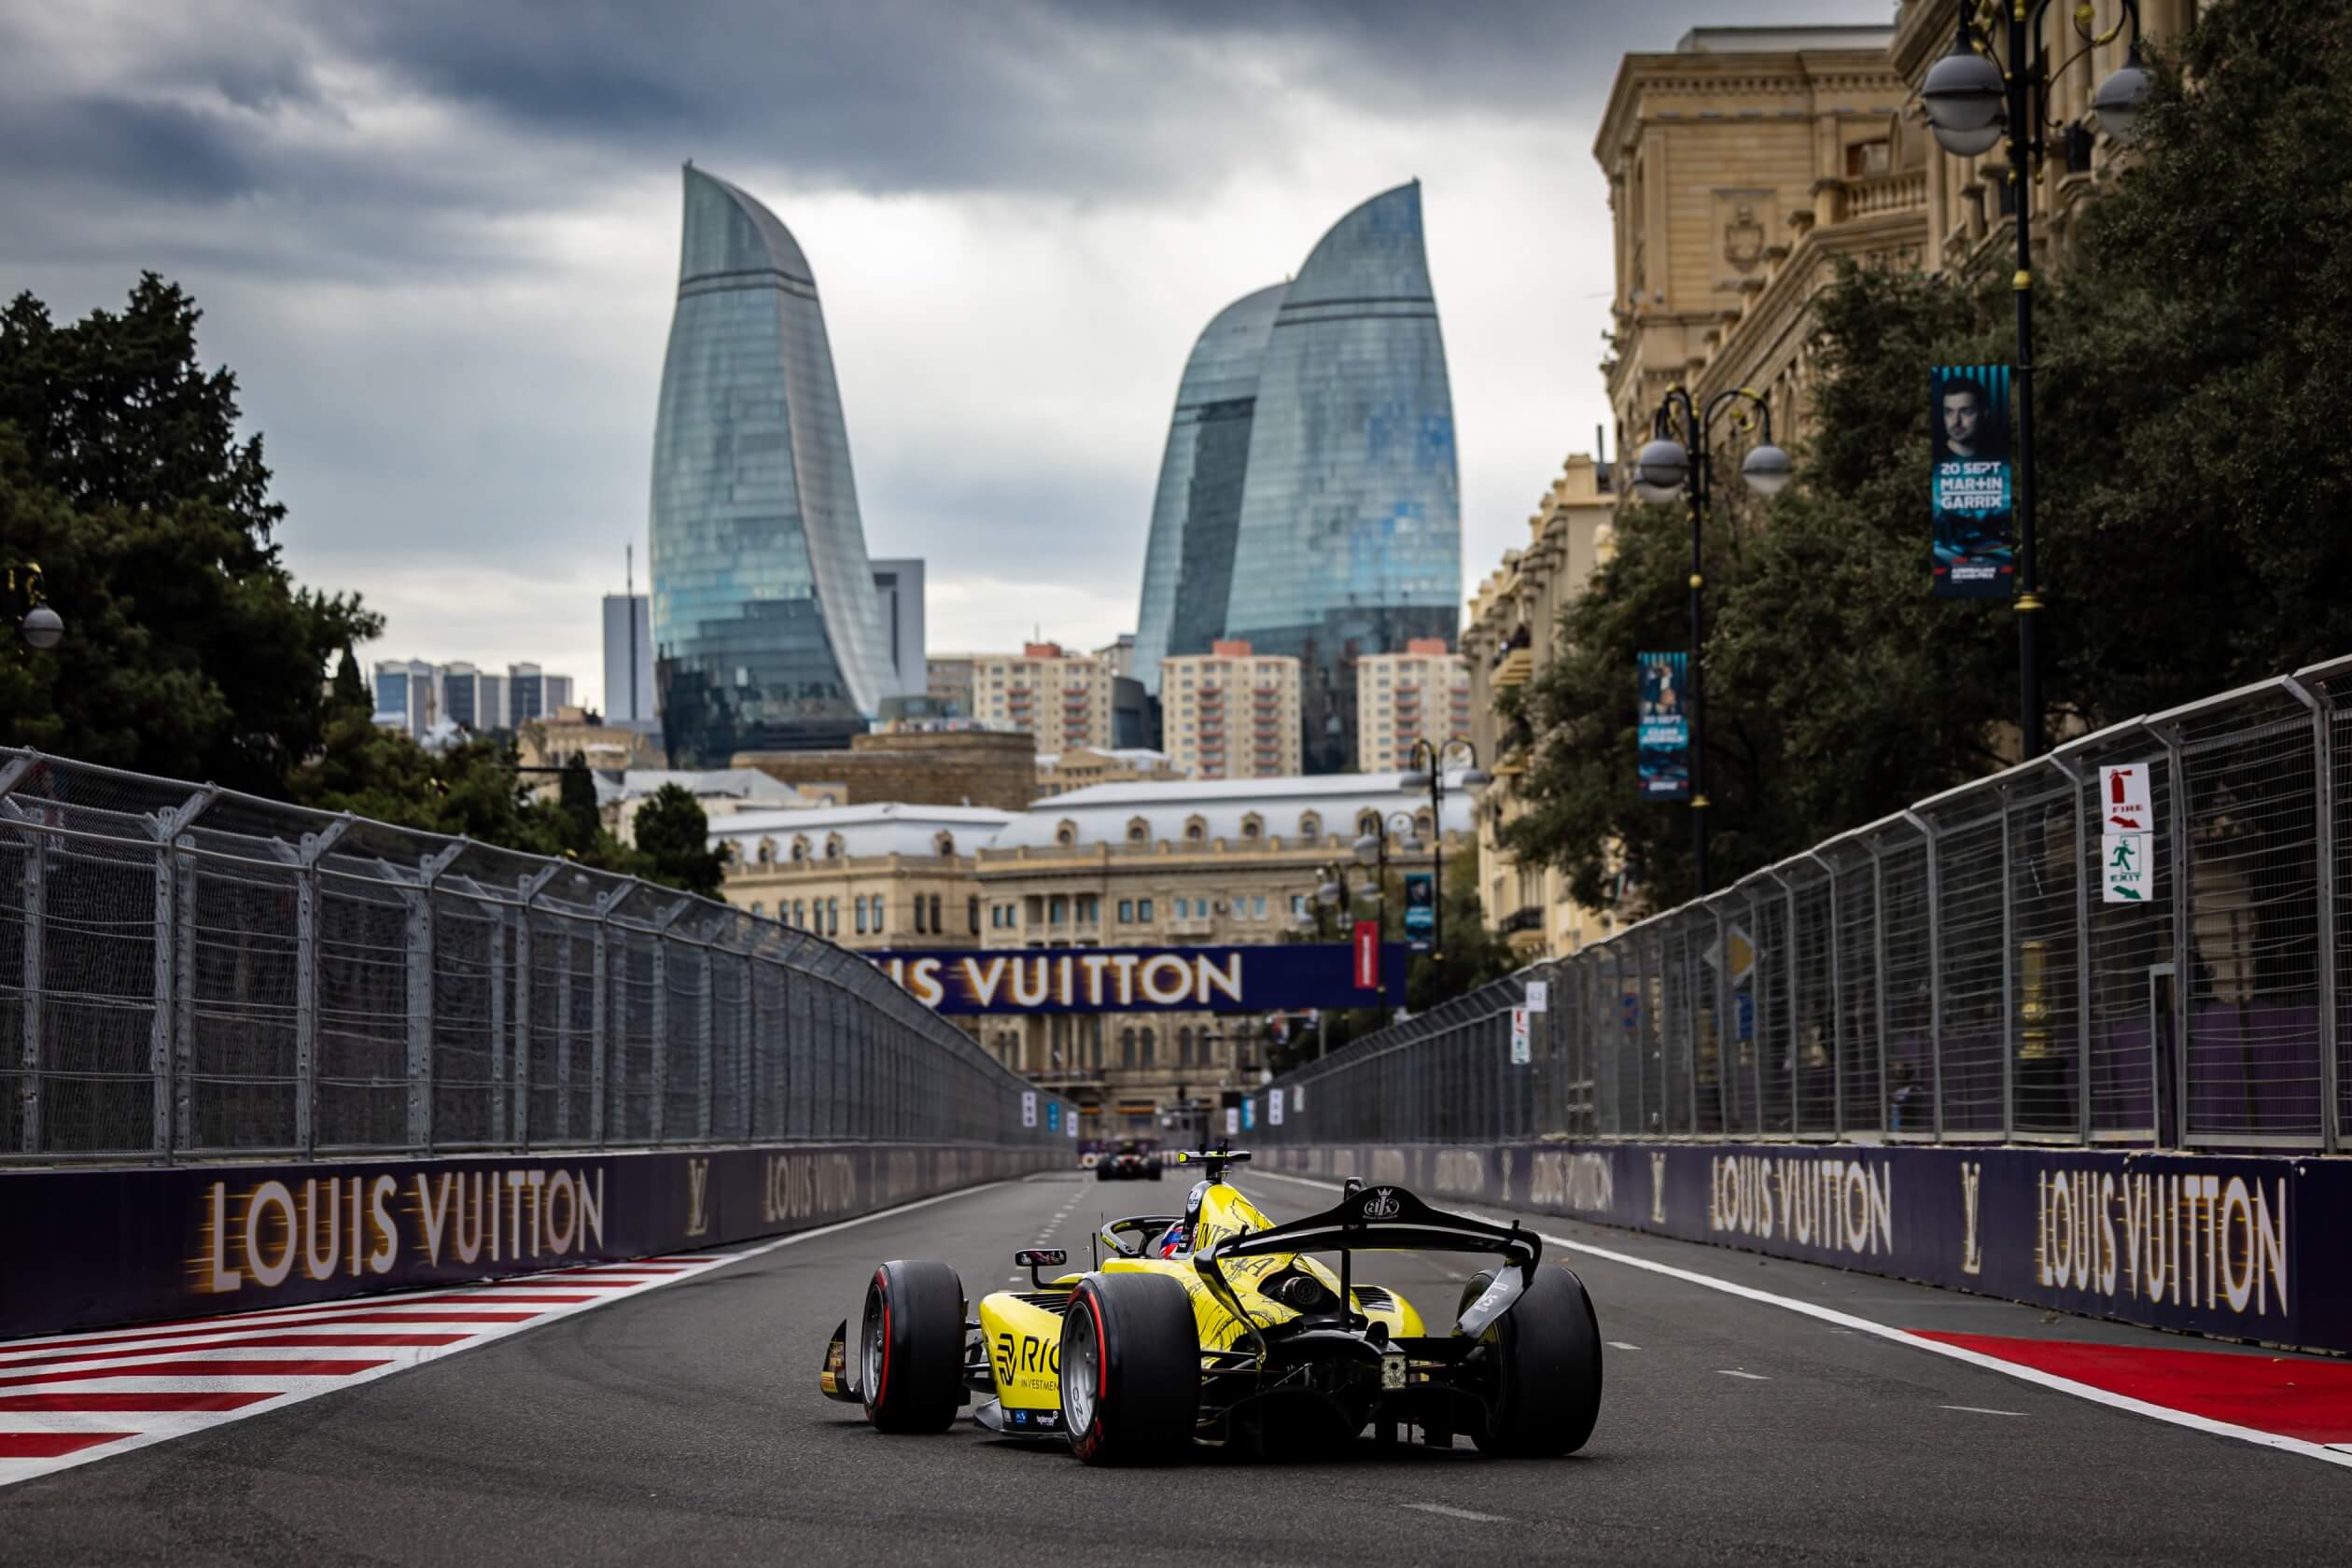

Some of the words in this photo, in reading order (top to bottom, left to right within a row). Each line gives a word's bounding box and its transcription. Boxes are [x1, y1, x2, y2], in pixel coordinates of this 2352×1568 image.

[1940, 462, 1961, 475] 20
[1963, 461, 2001, 475] SEPT
[1940, 496, 2002, 510] GARRIX
[2112, 805, 2143, 813] FIRE
[869, 958, 944, 1008] IS
[963, 953, 1242, 1006] VUITTON
[213, 1174, 399, 1294] LOUIS
[417, 1167, 604, 1268] VUITTON
[1713, 1155, 1773, 1239] LOUIS
[1777, 1156, 1892, 1256] VUITTON
[2039, 1169, 2117, 1297] LOUIS
[2122, 1172, 2288, 1318] VUITTON
